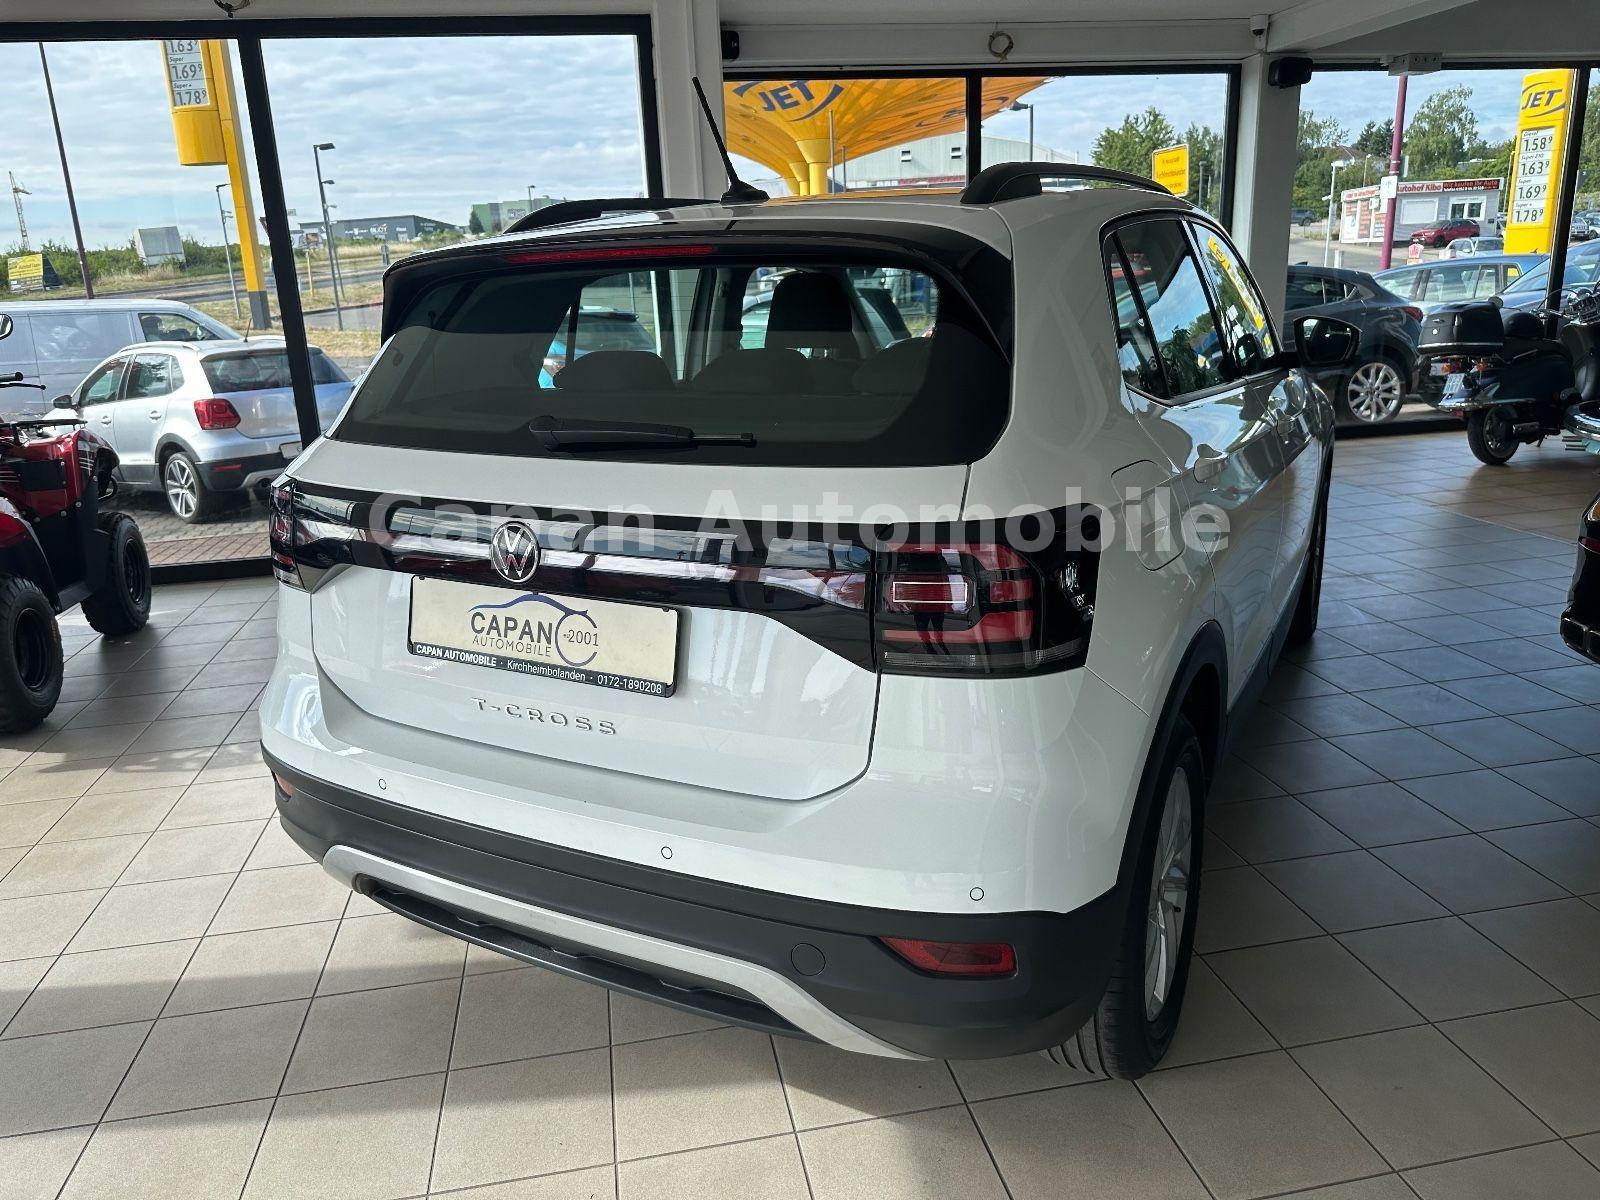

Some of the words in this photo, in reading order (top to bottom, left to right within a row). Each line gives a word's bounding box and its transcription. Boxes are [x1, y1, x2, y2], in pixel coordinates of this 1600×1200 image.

[757, 80, 816, 112] JET
[1521, 88, 1564, 110] JET
[1424, 183, 1442, 191] Kibo
[470, 611, 553, 645] CAPAN
[568, 629, 599, 647] 2001
[472, 635, 552, 658] AUTOMOBILE
[416, 644, 443, 658] CAPAN
[443, 648, 497, 668] AUTOMOBILE
[507, 659, 586, 682] Kirchheimbolanden
[597, 674, 663, 695] 0172-1890208
[470, 697, 617, 735] T-CROSS
